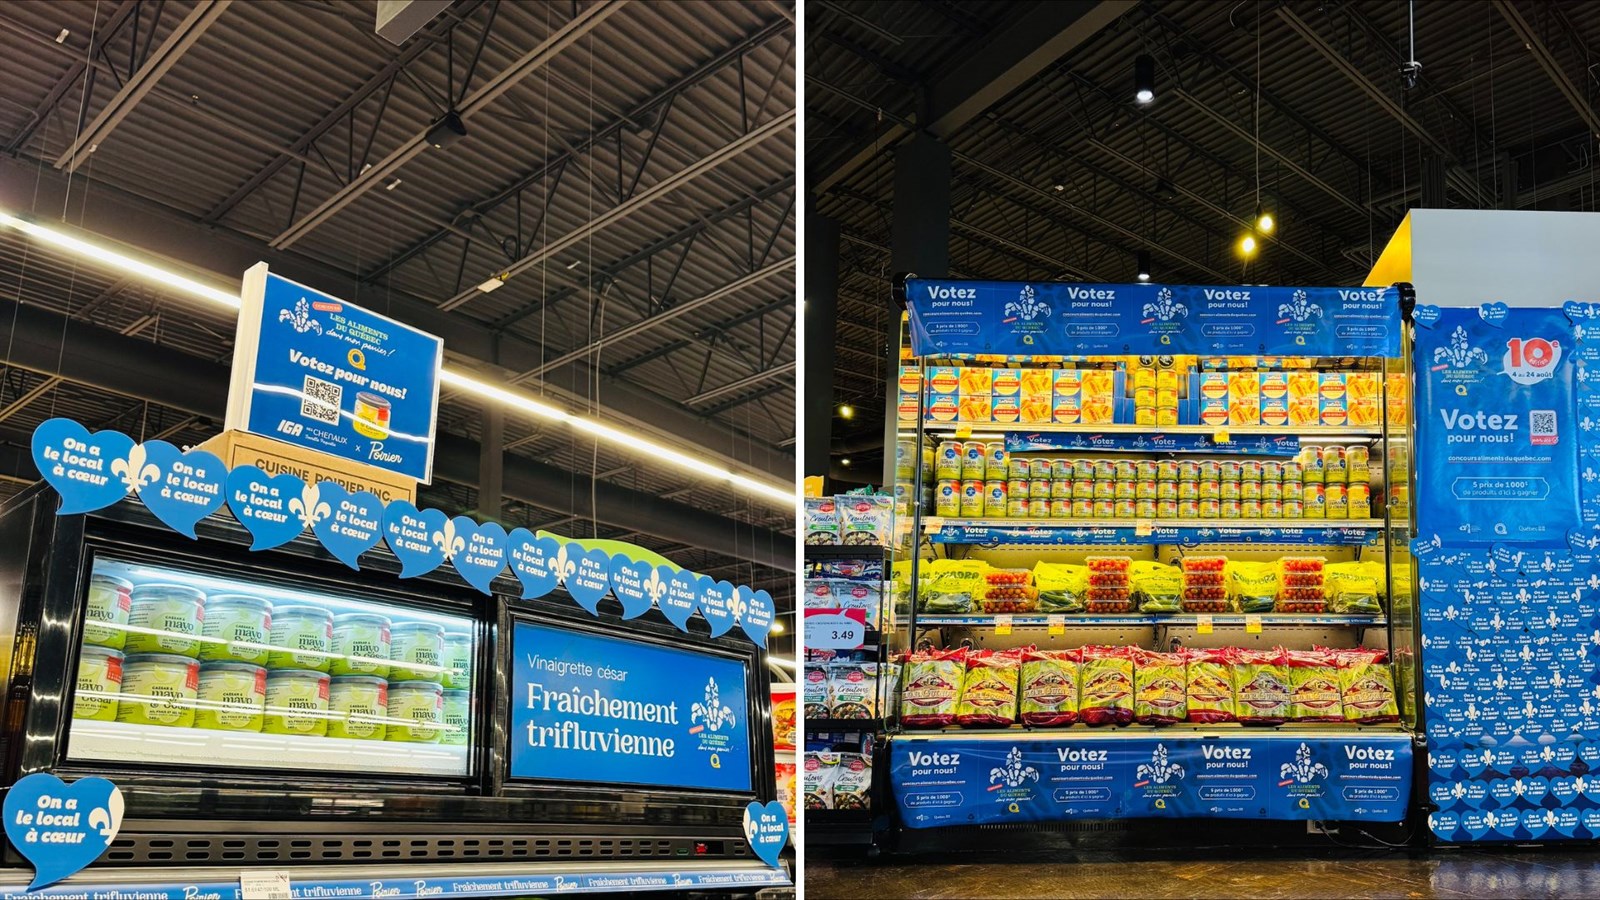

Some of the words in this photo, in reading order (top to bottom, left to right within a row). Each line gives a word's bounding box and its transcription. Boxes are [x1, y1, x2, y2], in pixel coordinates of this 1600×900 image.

[928, 286, 976, 299] Votez
[1068, 287, 1115, 299] Votez
[1204, 289, 1250, 300] Votez
[1339, 290, 1385, 301] Votez
[330, 313, 345, 324] LES
[348, 320, 388, 340] ALIMENTS
[336, 324, 347, 332] DU
[349, 329, 381, 345] QUÉBEC
[290, 349, 334, 375] Votez
[334, 368, 369, 386] pour
[370, 380, 407, 399] nous!
[1440, 409, 1518, 430] Votez
[277, 420, 303, 436] IGA
[1447, 434, 1476, 444] pour
[1480, 433, 1513, 442] nous!
[64, 438, 86, 453] On
[89, 445, 100, 455] a
[368, 441, 402, 463] Poirier
[44, 446, 60, 460] le
[63, 450, 103, 471] local
[53, 464, 64, 476] à
[68, 469, 108, 486] cœur
[173, 462, 193, 475] On
[196, 468, 205, 478] a
[255, 459, 309, 481] CUISINE
[167, 473, 180, 486] le
[183, 476, 218, 495] local
[250, 482, 268, 494] On
[270, 488, 279, 496] a
[1479, 481, 1492, 489] prix
[161, 486, 171, 498] à
[174, 489, 210, 505] cœur
[235, 490, 248, 502] le
[250, 494, 282, 509] local
[243, 505, 252, 516] à
[255, 509, 288, 523] cœur
[341, 501, 357, 512] On
[360, 507, 367, 516] a
[336, 511, 346, 521] le
[349, 514, 378, 531] local
[402, 515, 416, 527] On
[419, 521, 426, 529] a
[331, 522, 339, 532] à
[342, 526, 371, 541] cœur
[390, 523, 399, 533] le
[402, 526, 428, 541] local
[472, 533, 485, 543] On
[396, 536, 403, 547] à
[405, 541, 432, 554] cœur
[469, 543, 478, 553] le
[480, 545, 503, 558] local
[523, 543, 535, 552] On
[466, 554, 472, 563] à
[475, 557, 498, 568] cœur
[513, 549, 521, 558] le
[523, 552, 544, 566] local
[518, 562, 524, 571] à
[526, 566, 548, 578] cœur
[165, 620, 194, 633] mayo
[235, 629, 262, 642] mayo
[832, 631, 854, 640] 3.49
[299, 638, 324, 650] mayo
[353, 644, 379, 656] mayo
[416, 652, 438, 662] mayo
[527, 653, 592, 677] Vinaigrette
[598, 665, 628, 682] césar
[837, 685, 869, 693] Croutons
[526, 682, 679, 725] Fraîchement
[413, 712, 436, 722] mayo
[527, 719, 675, 757] trifluvienne
[909, 752, 960, 766] Votez
[1057, 748, 1107, 762] Votez
[1202, 745, 1251, 759] Votez
[1344, 745, 1394, 760] Votez
[912, 768, 932, 776] pour
[1061, 764, 1079, 772] pour
[37, 795, 62, 809] On
[65, 799, 77, 810] a
[16, 810, 33, 825] le
[36, 811, 80, 826] local
[25, 828, 38, 843] à
[41, 832, 86, 843] cœur
[303, 887, 362, 897] trifluvienne
[453, 882, 502, 892] Fraîchement
[504, 880, 549, 890] trifluvienne
